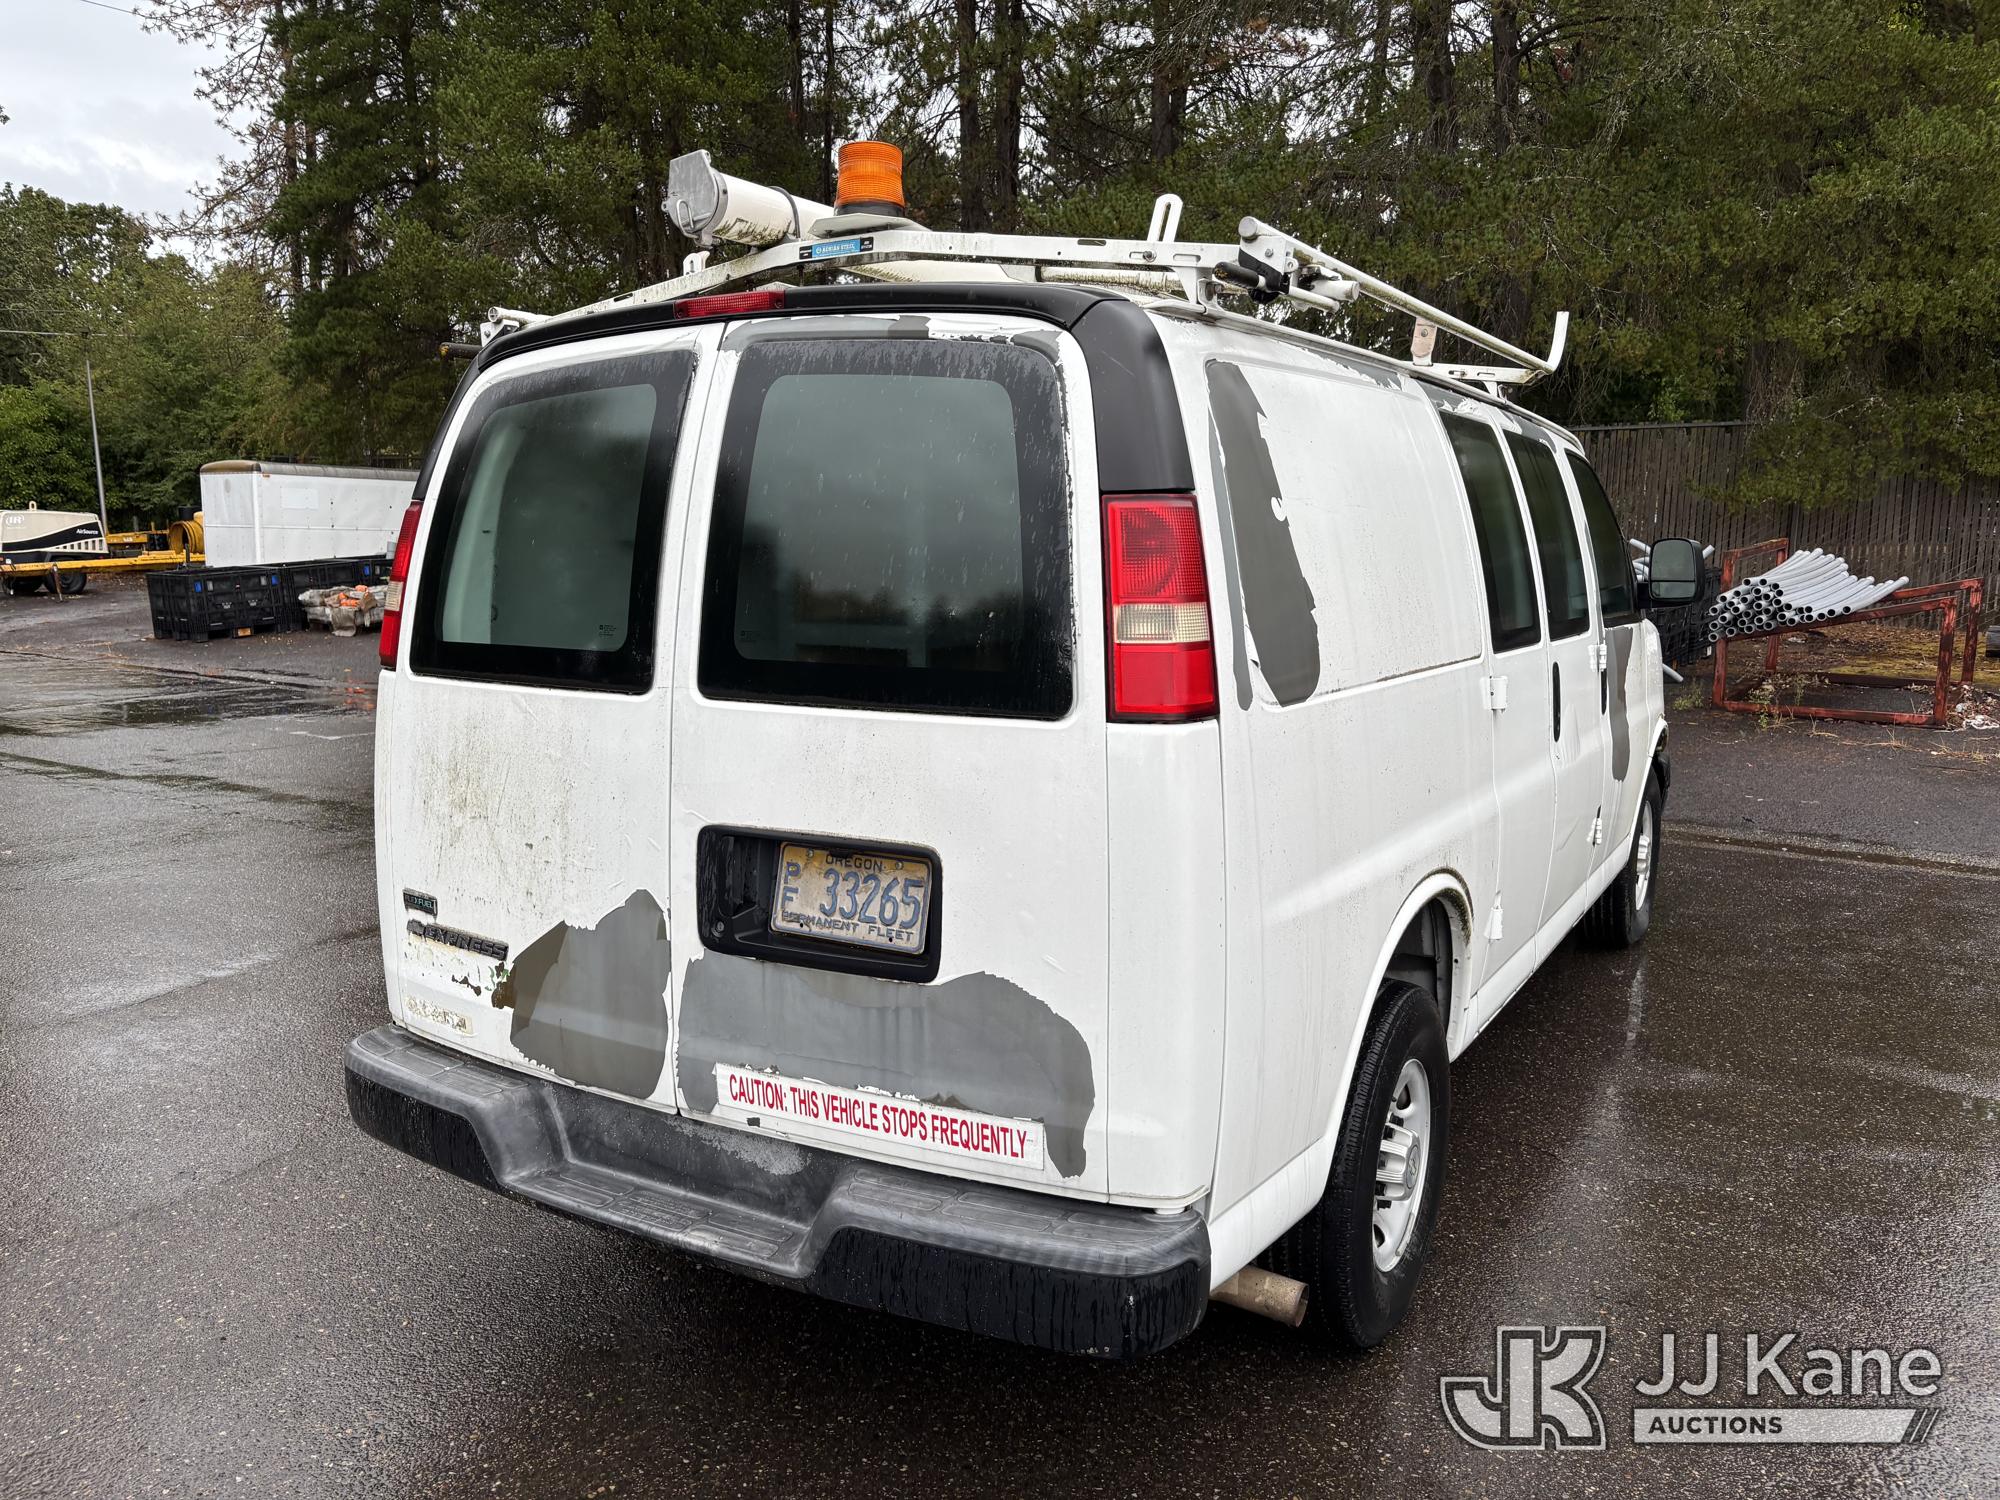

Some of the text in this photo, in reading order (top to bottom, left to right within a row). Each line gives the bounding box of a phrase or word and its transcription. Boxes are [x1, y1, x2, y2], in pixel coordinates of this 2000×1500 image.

[825, 854, 883, 872] OREGON
[820, 868, 925, 930] 33265
[868, 925, 914, 942] FLEET
[729, 1074, 1028, 1159] CAUTION: THIS VEHICLE STOPS FREQUENTLY
